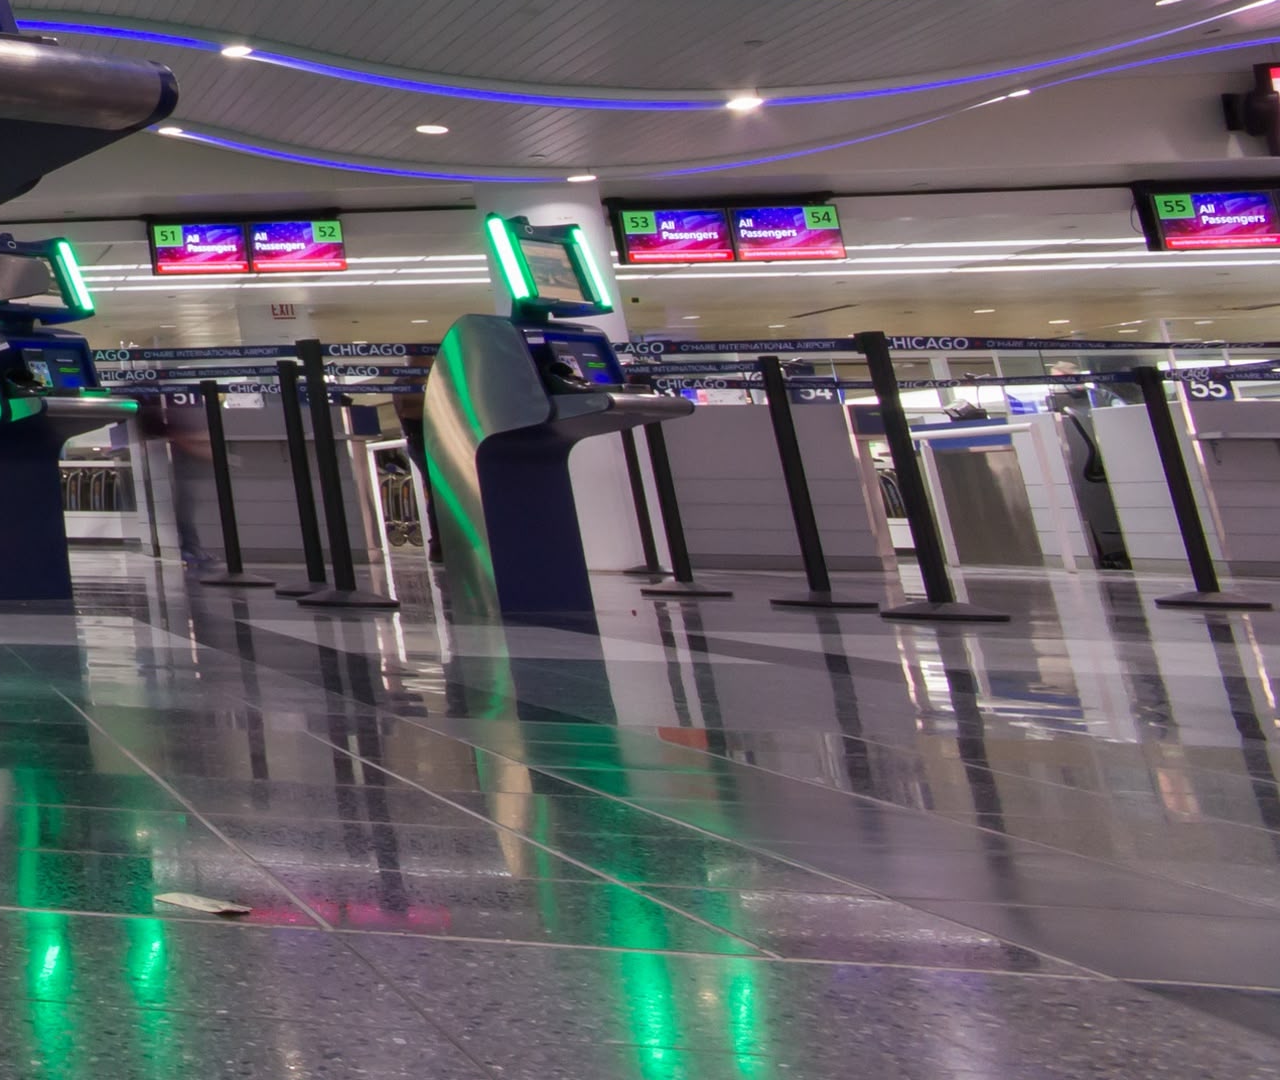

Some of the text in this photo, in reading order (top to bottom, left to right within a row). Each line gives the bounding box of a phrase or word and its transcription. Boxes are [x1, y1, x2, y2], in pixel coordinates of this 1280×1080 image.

[1163, 200, 1186, 213] 55
[1200, 203, 1215, 214] All
[630, 216, 650, 229] 53
[811, 211, 832, 223] 54
[1201, 214, 1266, 225] Passengers
[661, 220, 675, 230] All
[739, 218, 753, 228] All
[160, 230, 176, 242] 51
[254, 232, 268, 241] All
[318, 226, 336, 238] 52
[662, 230, 719, 241] Passengers
[740, 228, 797, 240] Passengers
[186, 234, 199, 243] All
[187, 244, 237, 253] Passengers
[255, 242, 306, 252] Passengers
[612, 340, 836, 354] CAGO O'HARE INTERNATIONAL AIRPORT
[886, 337, 969, 350] CHICAGO
[143, 347, 280, 358] O'HARE INTERNATIONAL AIRPORT
[328, 344, 407, 356] CHICAGO
[324, 366, 380, 377] HICAGO
[624, 363, 755, 373] 'HARE INTERNATIONAL AIRPORT
[101, 369, 157, 380] HICAGO
[228, 384, 281, 393] CHICAG
[656, 379, 727, 389] CHICAGO
[897, 379, 961, 388] HICAGO
[1190, 379, 1228, 398] 55
